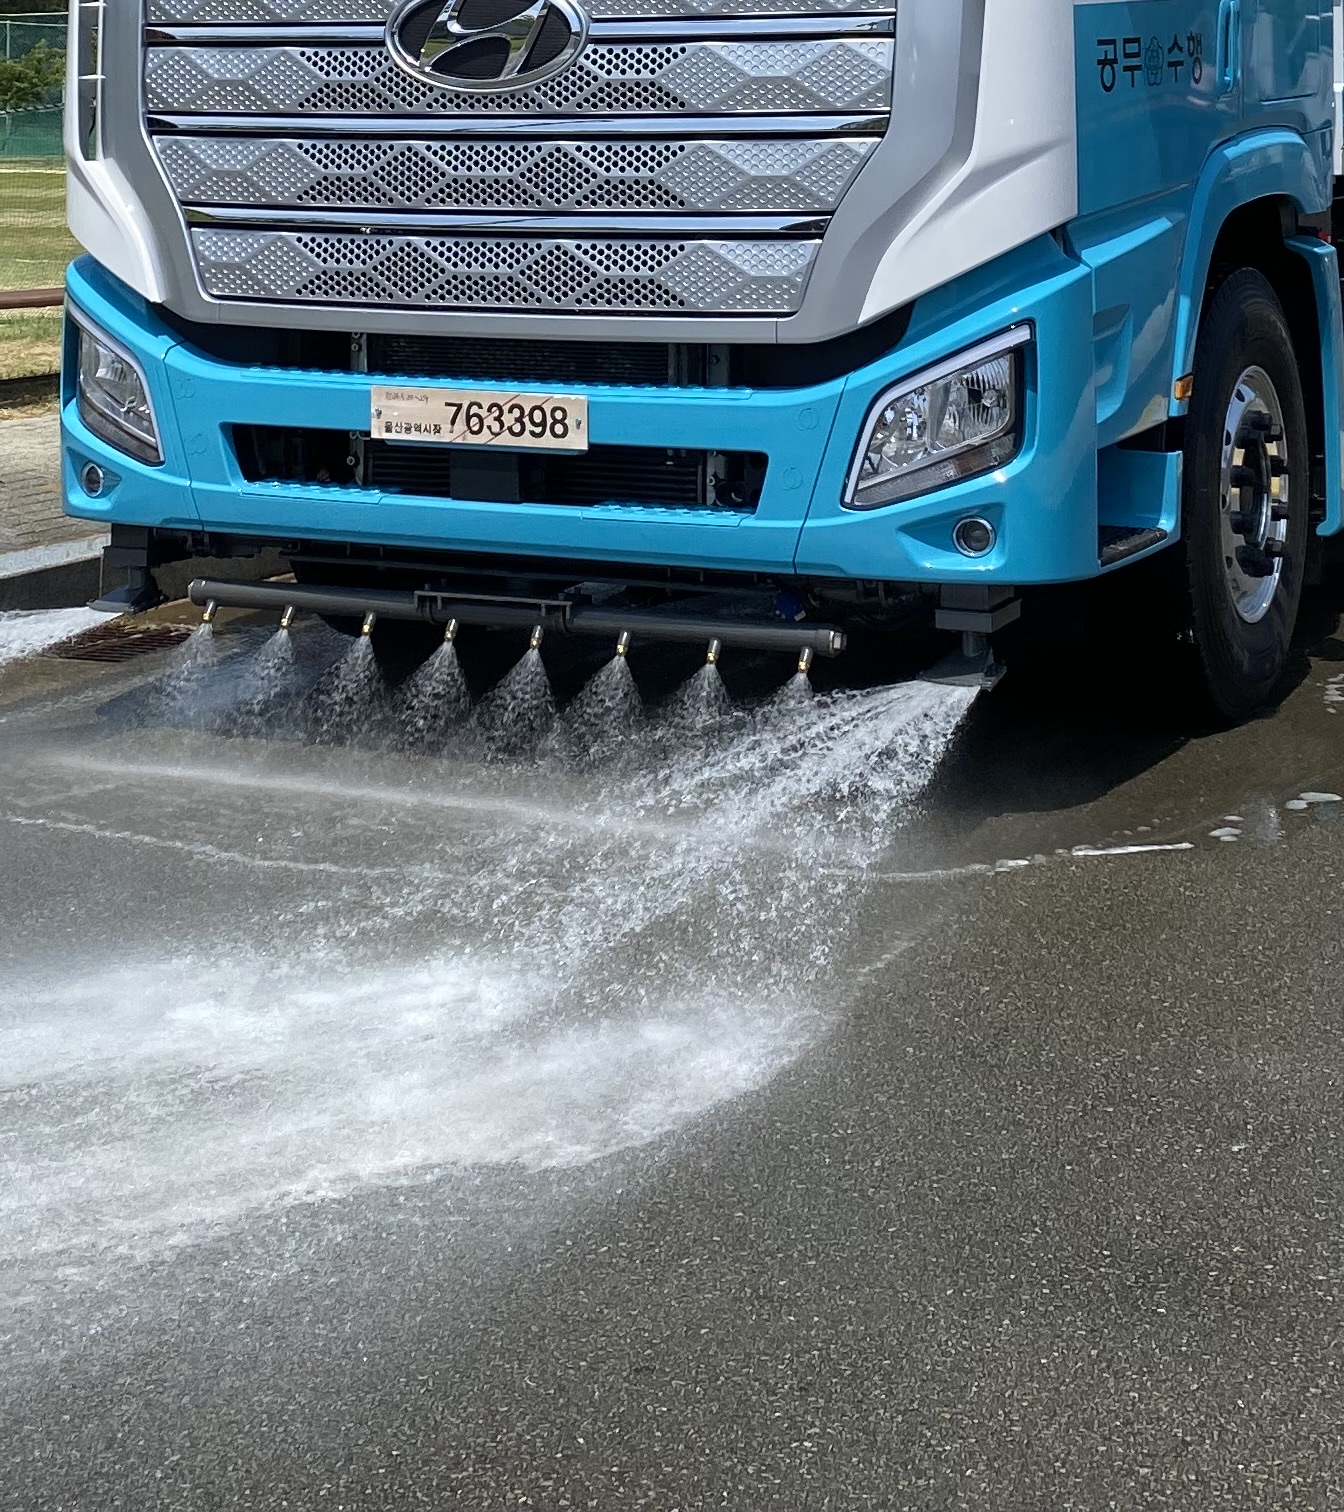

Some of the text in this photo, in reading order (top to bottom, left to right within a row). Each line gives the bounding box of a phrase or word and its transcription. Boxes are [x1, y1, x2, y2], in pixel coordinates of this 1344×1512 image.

[1096, 31, 1203, 93] 공무 수행
[384, 421, 443, 435] 울산광역시장
[444, 400, 569, 439] 763398
